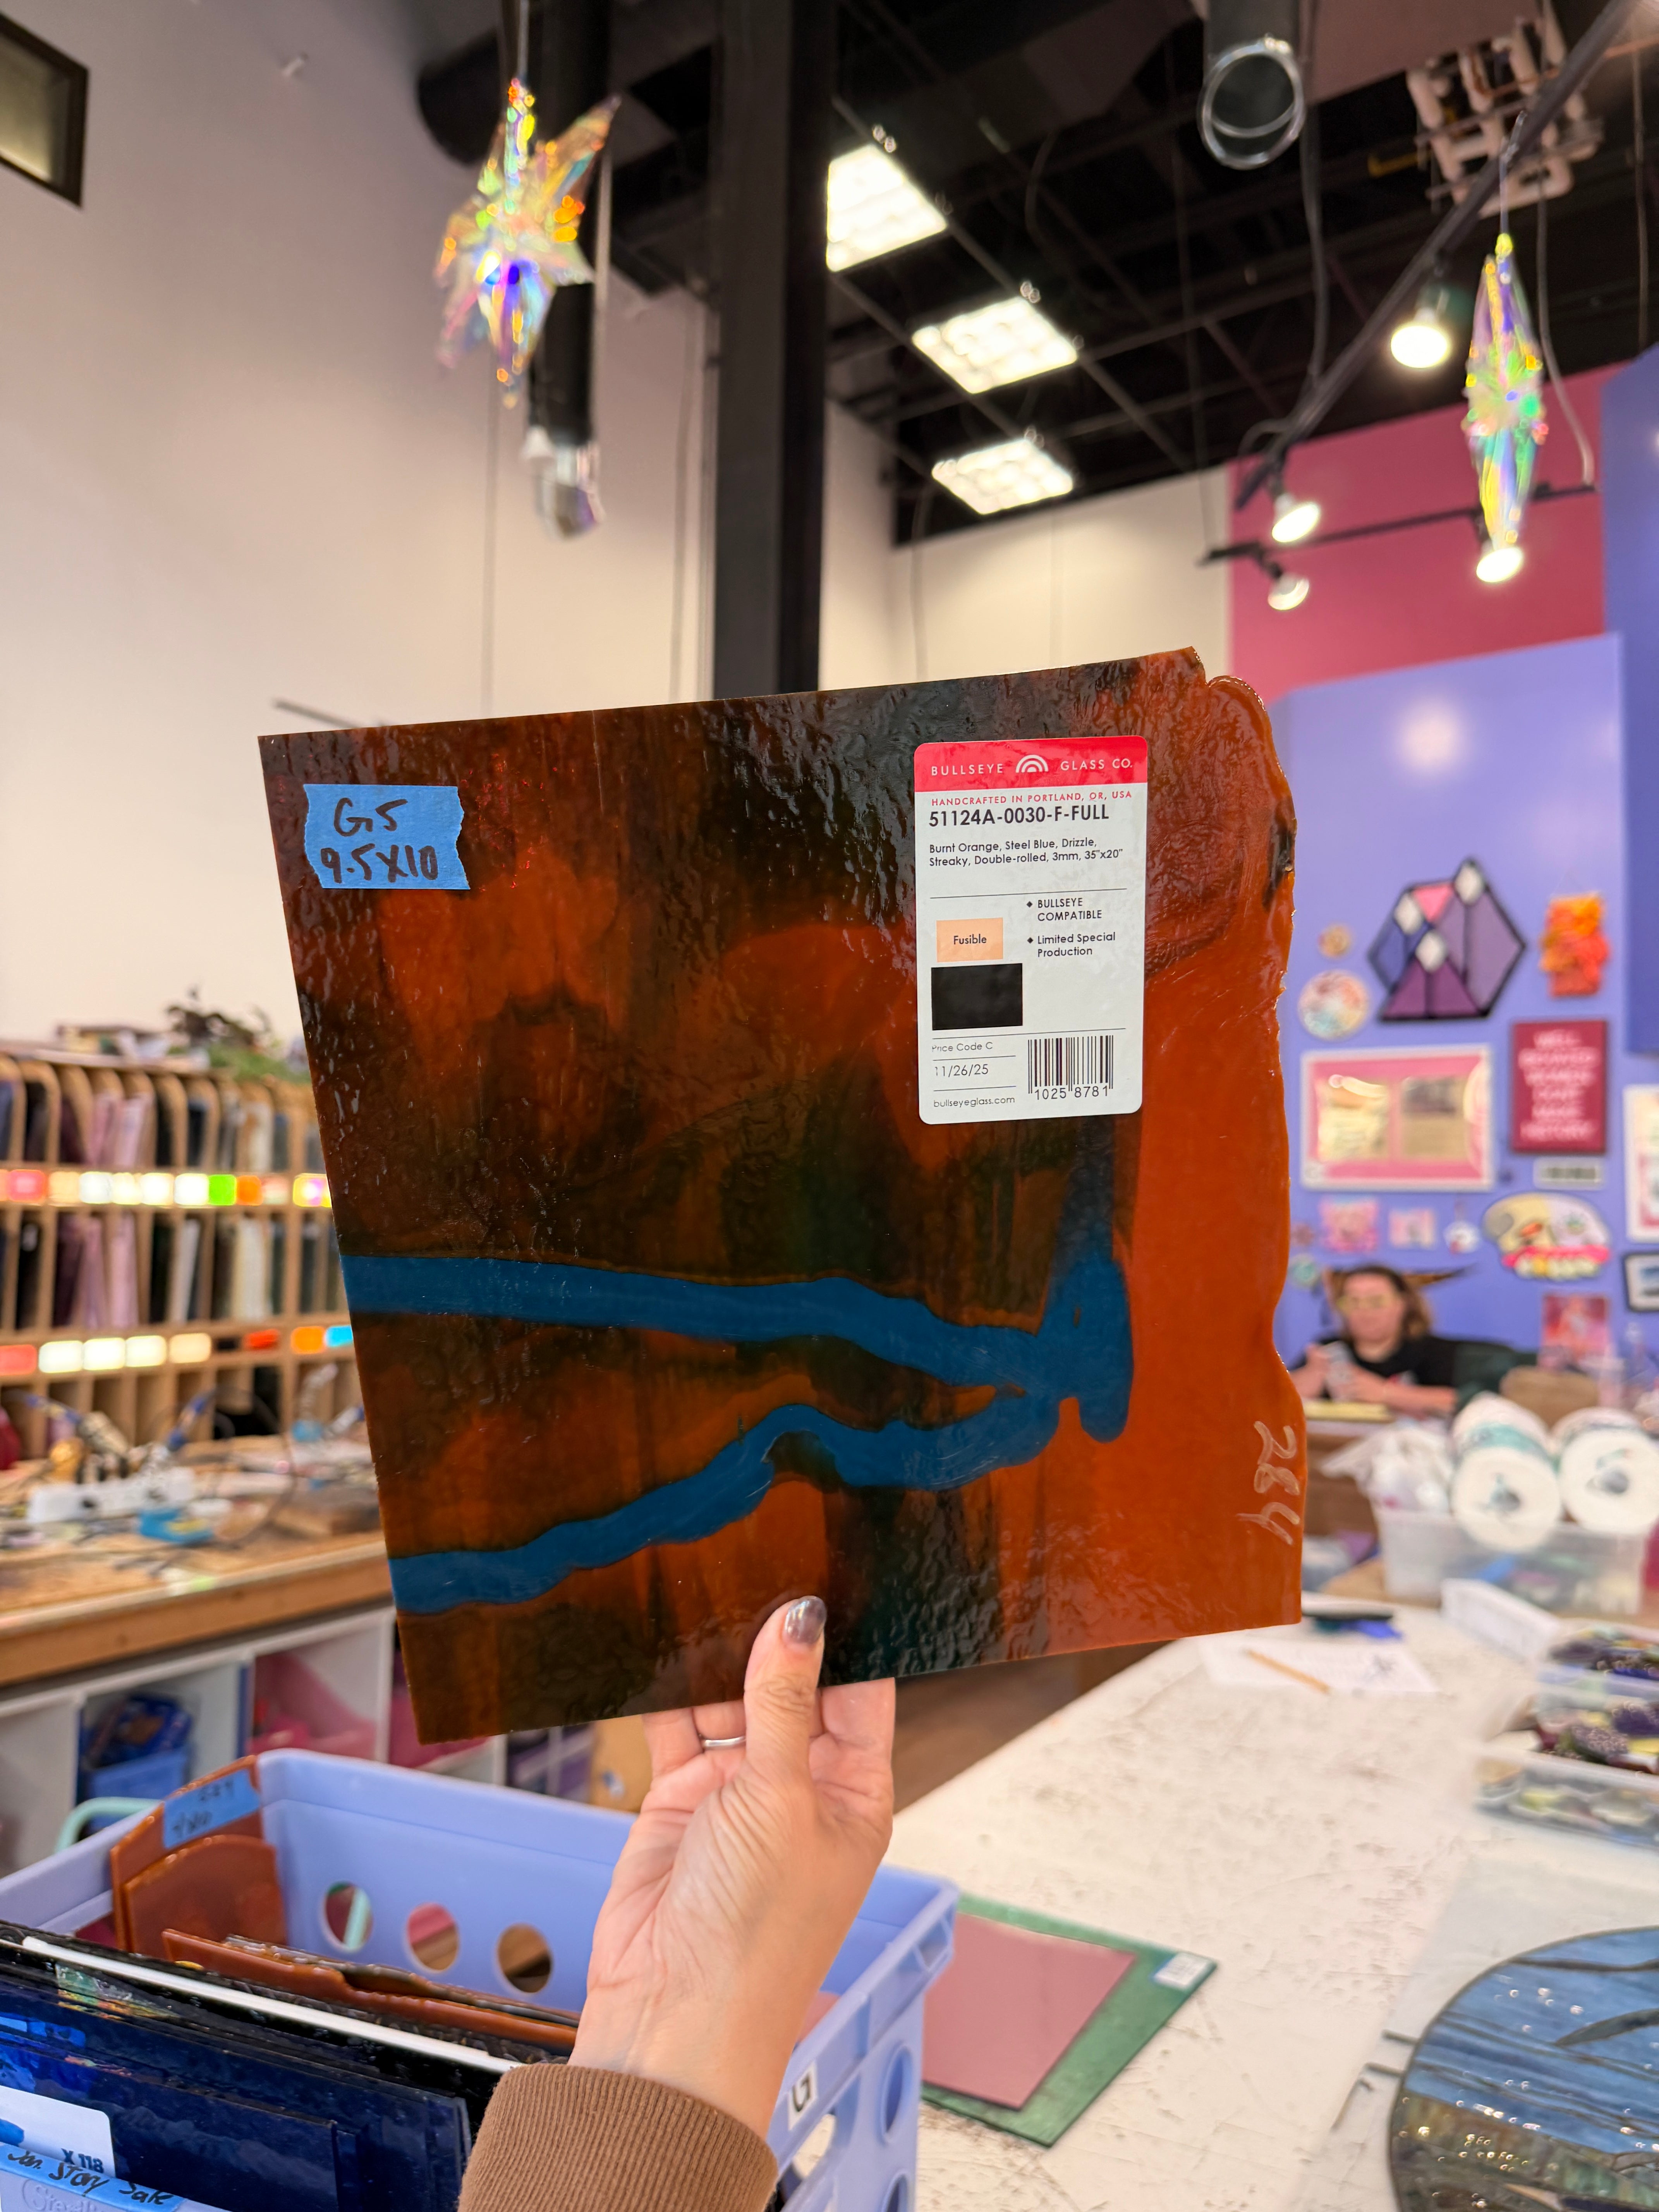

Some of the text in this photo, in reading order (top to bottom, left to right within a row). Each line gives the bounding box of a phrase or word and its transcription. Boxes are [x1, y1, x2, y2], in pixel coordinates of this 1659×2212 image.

[931, 758, 1133, 776] BULLSEYE GLASS CO.
[932, 796, 1007, 806] HANDCRAFTED
[1028, 793, 1084, 802] PORTLAND,
[1089, 792, 1107, 800] OR,
[1112, 790, 1132, 799] USA
[929, 804, 1109, 827] 51124A-0030-F-FULL
[929, 837, 1097, 853] Burnt Orange, Steel Blue, Drizzle,
[929, 856, 970, 867] Streaky,
[975, 852, 1049, 865] Double-rolled,
[1053, 852, 1081, 861] 3mm,
[1038, 898, 1083, 908] BULLSEYE
[1038, 910, 1102, 921] COMPATIBLE
[953, 934, 987, 945] Fusible
[1038, 932, 1115, 944] Limited Special
[1038, 947, 1092, 957] Production
[957, 1042, 982, 1051] Code
[934, 1064, 988, 1077] 11/26/25
[934, 1097, 1015, 1108] bullseyeglass.com
[61, 2148, 104, 2173] X 118
